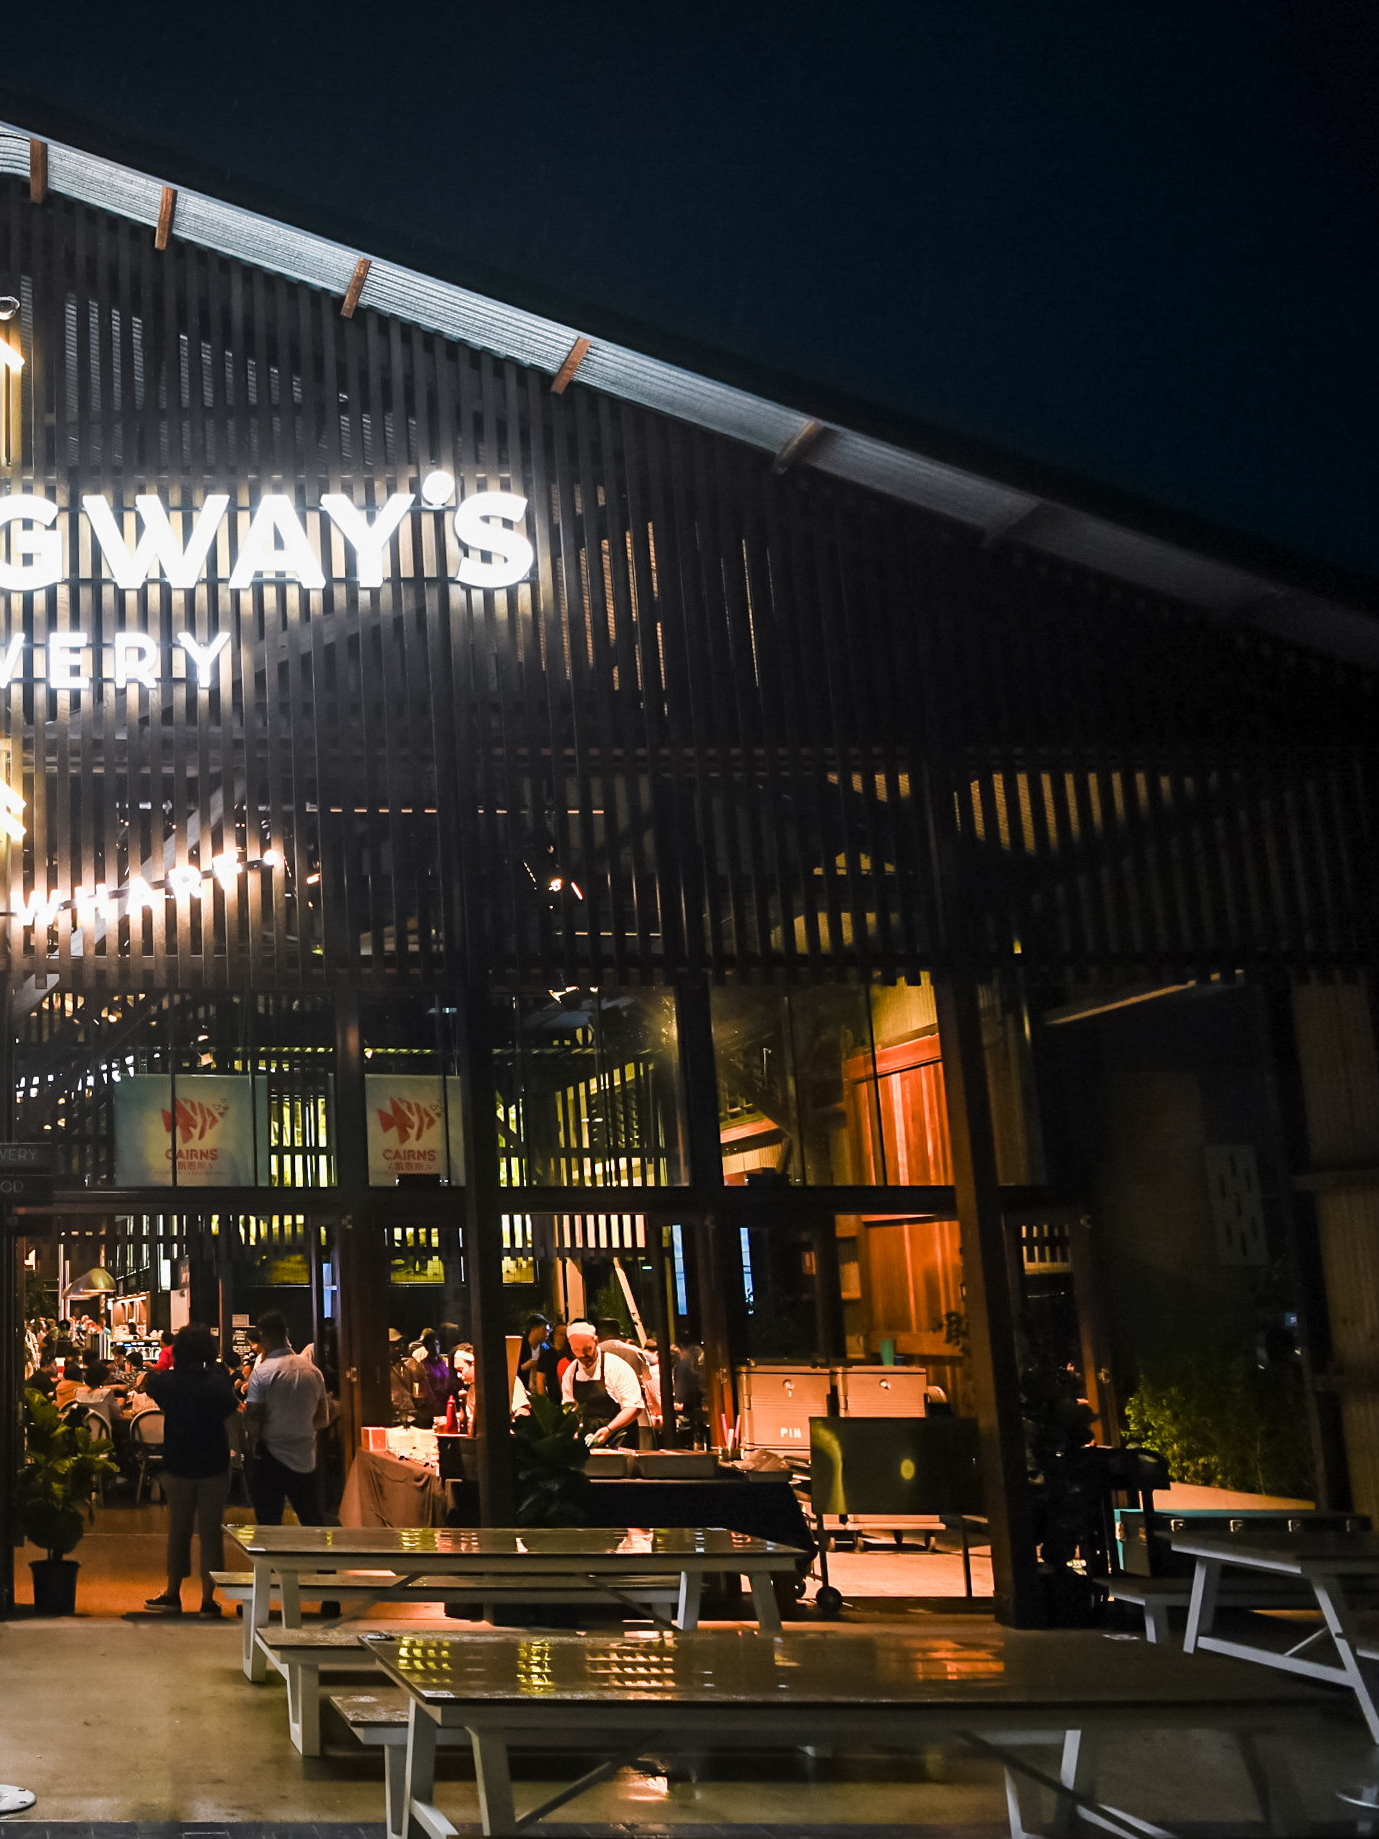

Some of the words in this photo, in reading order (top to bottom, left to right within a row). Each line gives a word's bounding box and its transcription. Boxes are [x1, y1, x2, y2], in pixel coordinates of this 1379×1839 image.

[11, 848, 241, 927] WHARF
[164, 1148, 219, 1161] CAIRNS
[382, 1148, 437, 1162] CAIRNS
